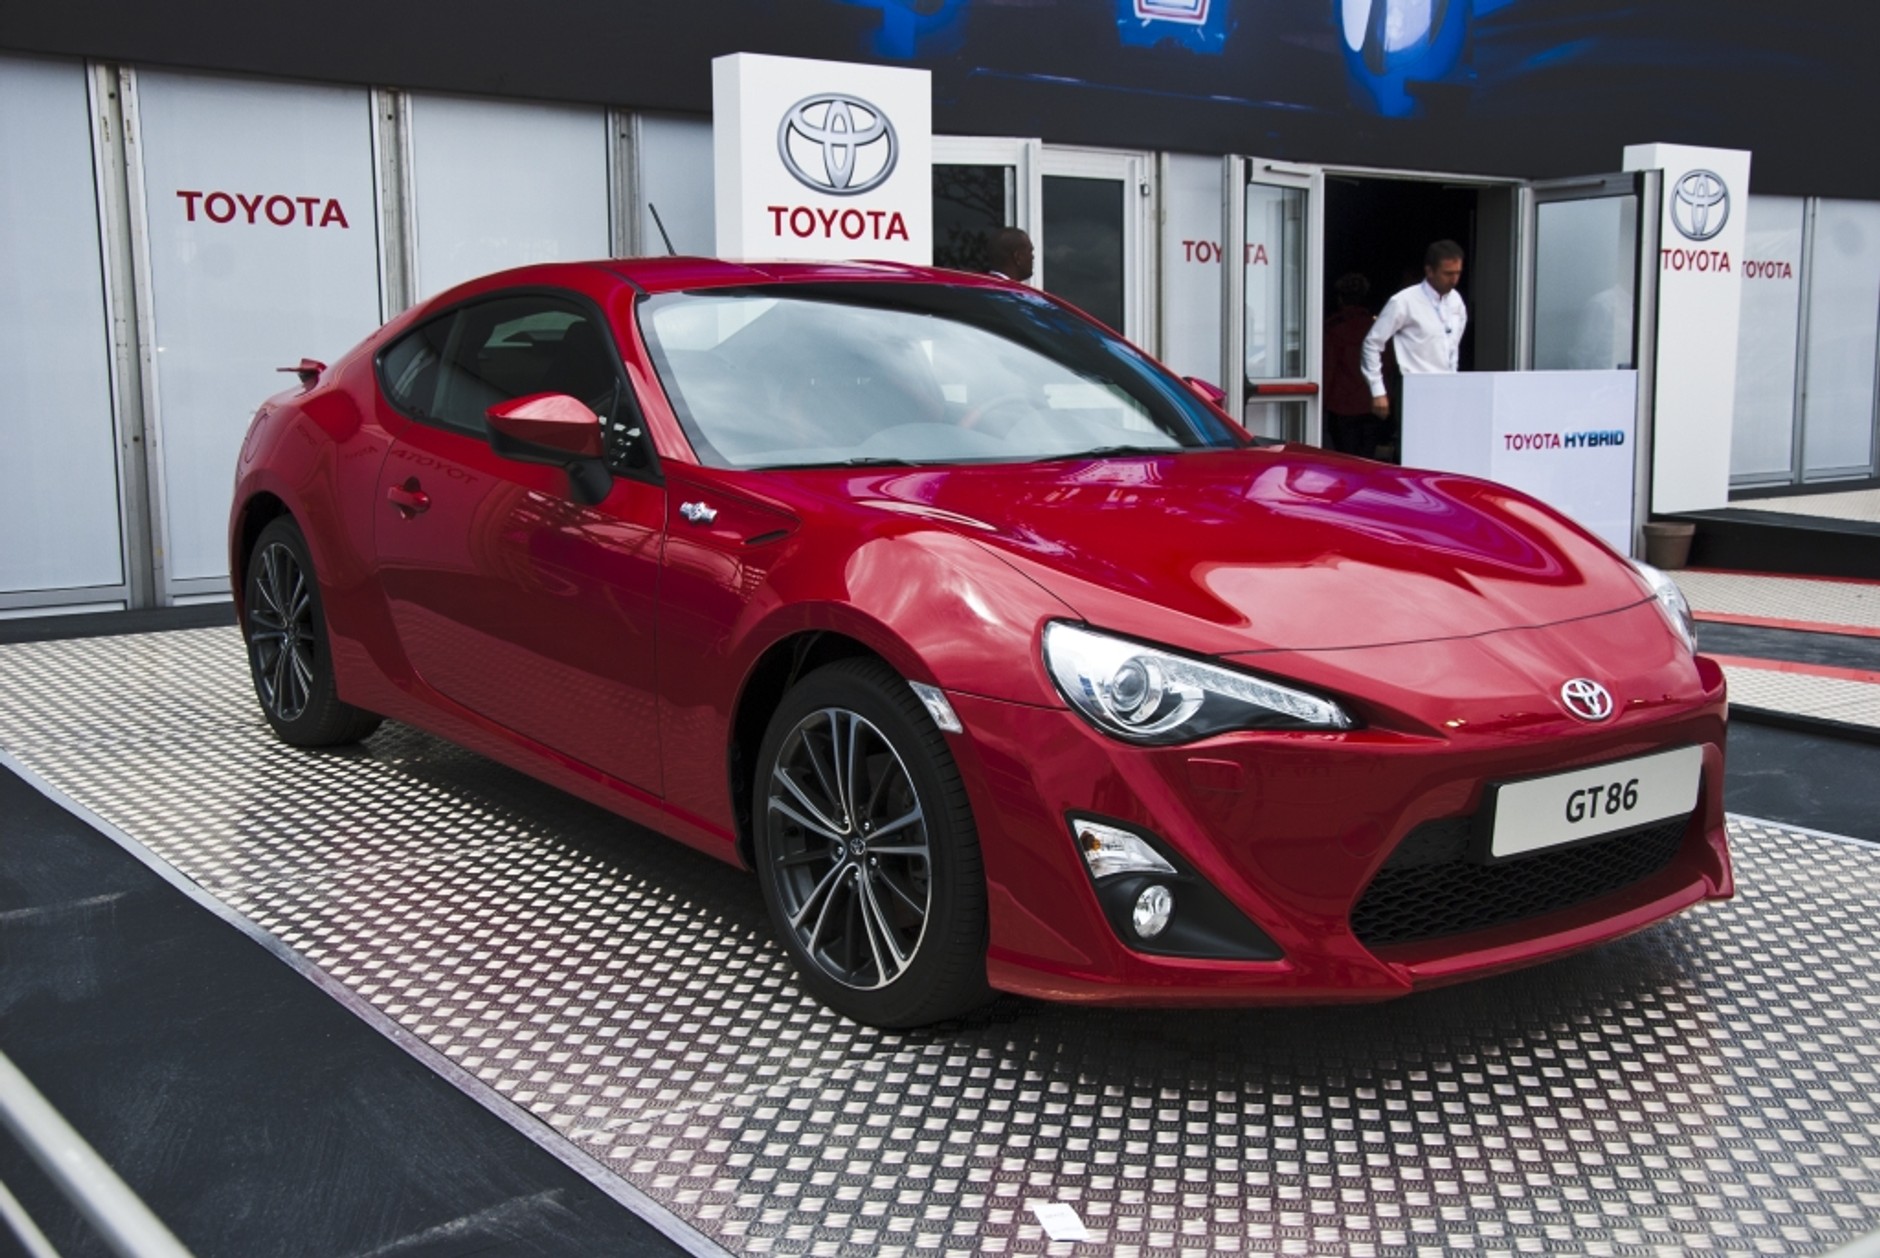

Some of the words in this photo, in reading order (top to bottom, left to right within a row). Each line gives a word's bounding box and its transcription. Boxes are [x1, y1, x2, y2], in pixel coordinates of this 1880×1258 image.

[176, 190, 349, 229] TOYOTA
[767, 205, 909, 241] TOYOTA
[1182, 240, 1268, 265] TOYTA
[1661, 248, 1730, 272] TOYOTA
[1504, 433, 1561, 451] TOYOTA
[1564, 430, 1624, 448] HYBRID
[1565, 778, 1639, 824] GT86
